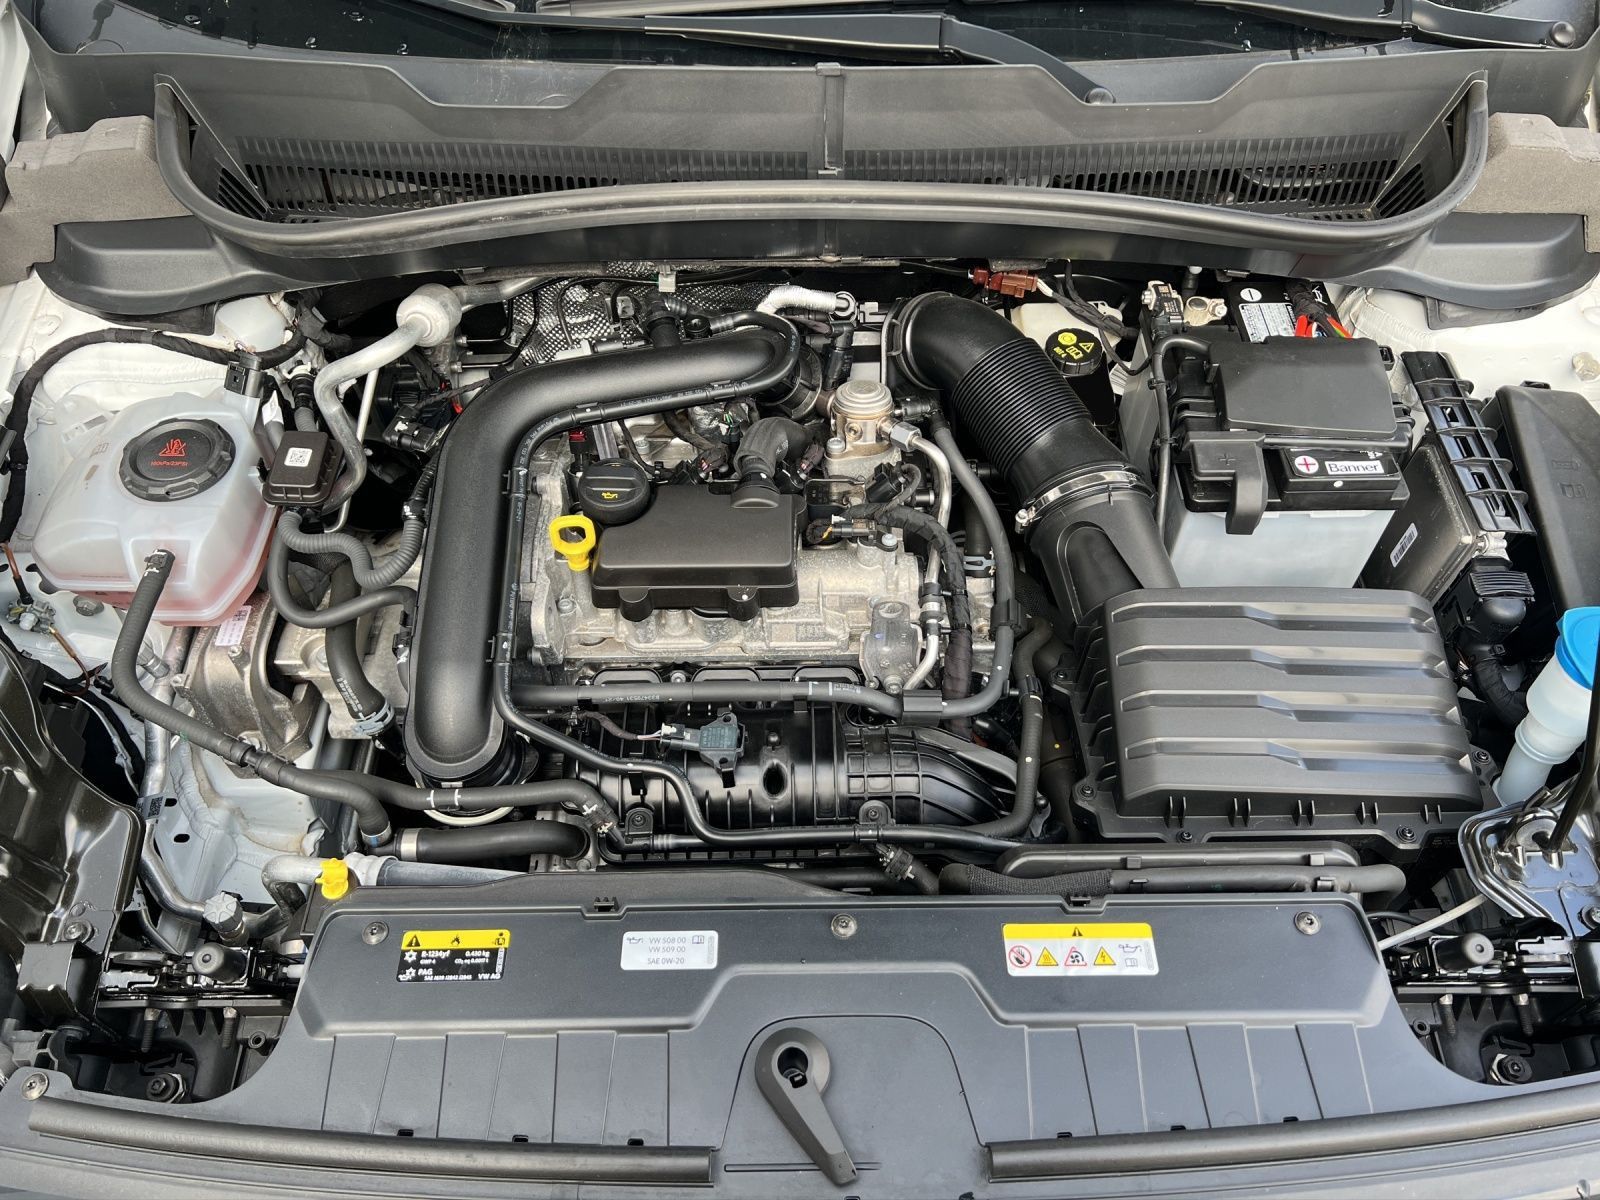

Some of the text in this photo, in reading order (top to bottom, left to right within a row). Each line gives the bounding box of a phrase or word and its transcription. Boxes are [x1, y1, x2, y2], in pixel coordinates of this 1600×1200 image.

[1328, 463, 1378, 473] Banner
[421, 950, 450, 959] R-1234yf
[482, 950, 490, 958] kg
[647, 957, 685, 965] SAE 0W-20
[417, 968, 433, 976] PAG
[490, 972, 501, 980] AG
